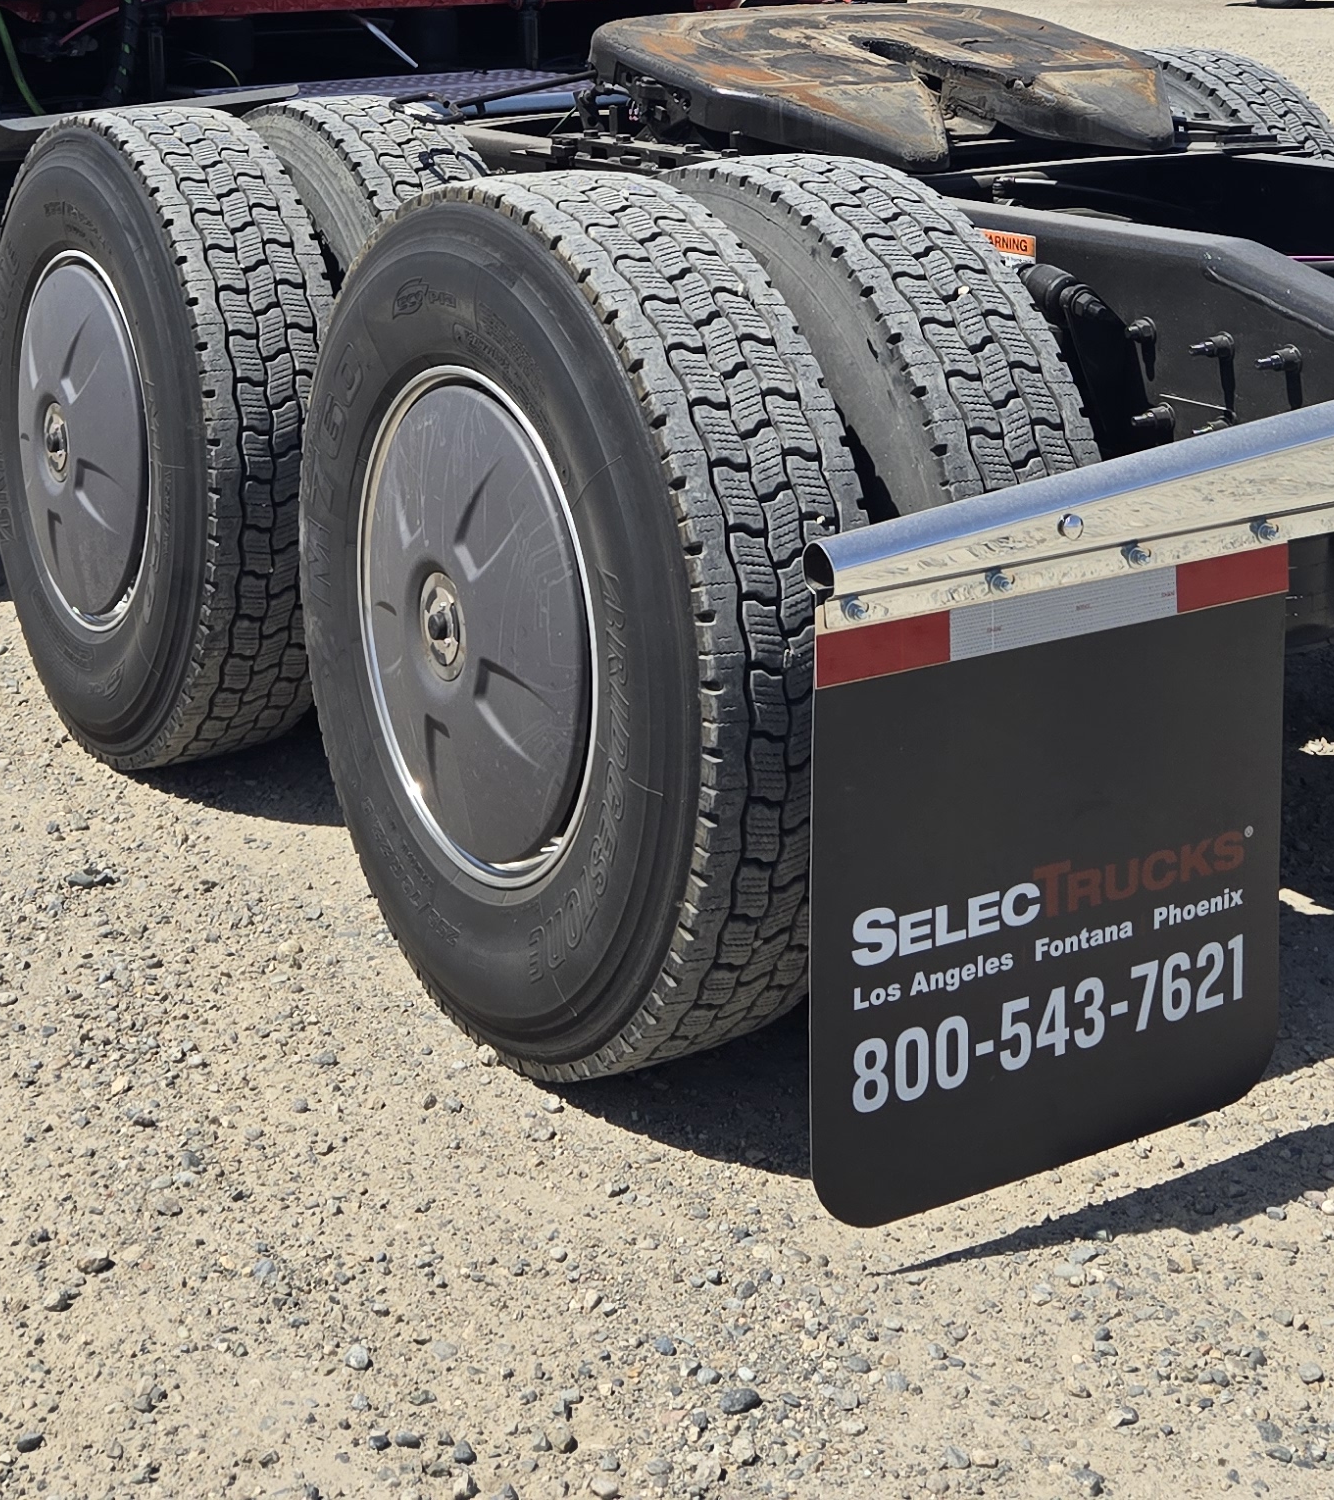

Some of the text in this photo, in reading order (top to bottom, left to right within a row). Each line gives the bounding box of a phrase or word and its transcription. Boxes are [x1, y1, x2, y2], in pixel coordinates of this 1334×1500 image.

[984, 233, 1028, 252] ARNING
[853, 887, 1244, 1011] Los Angeles Fontana Phoenix
[851, 933, 1245, 1114] 800-543-7621
